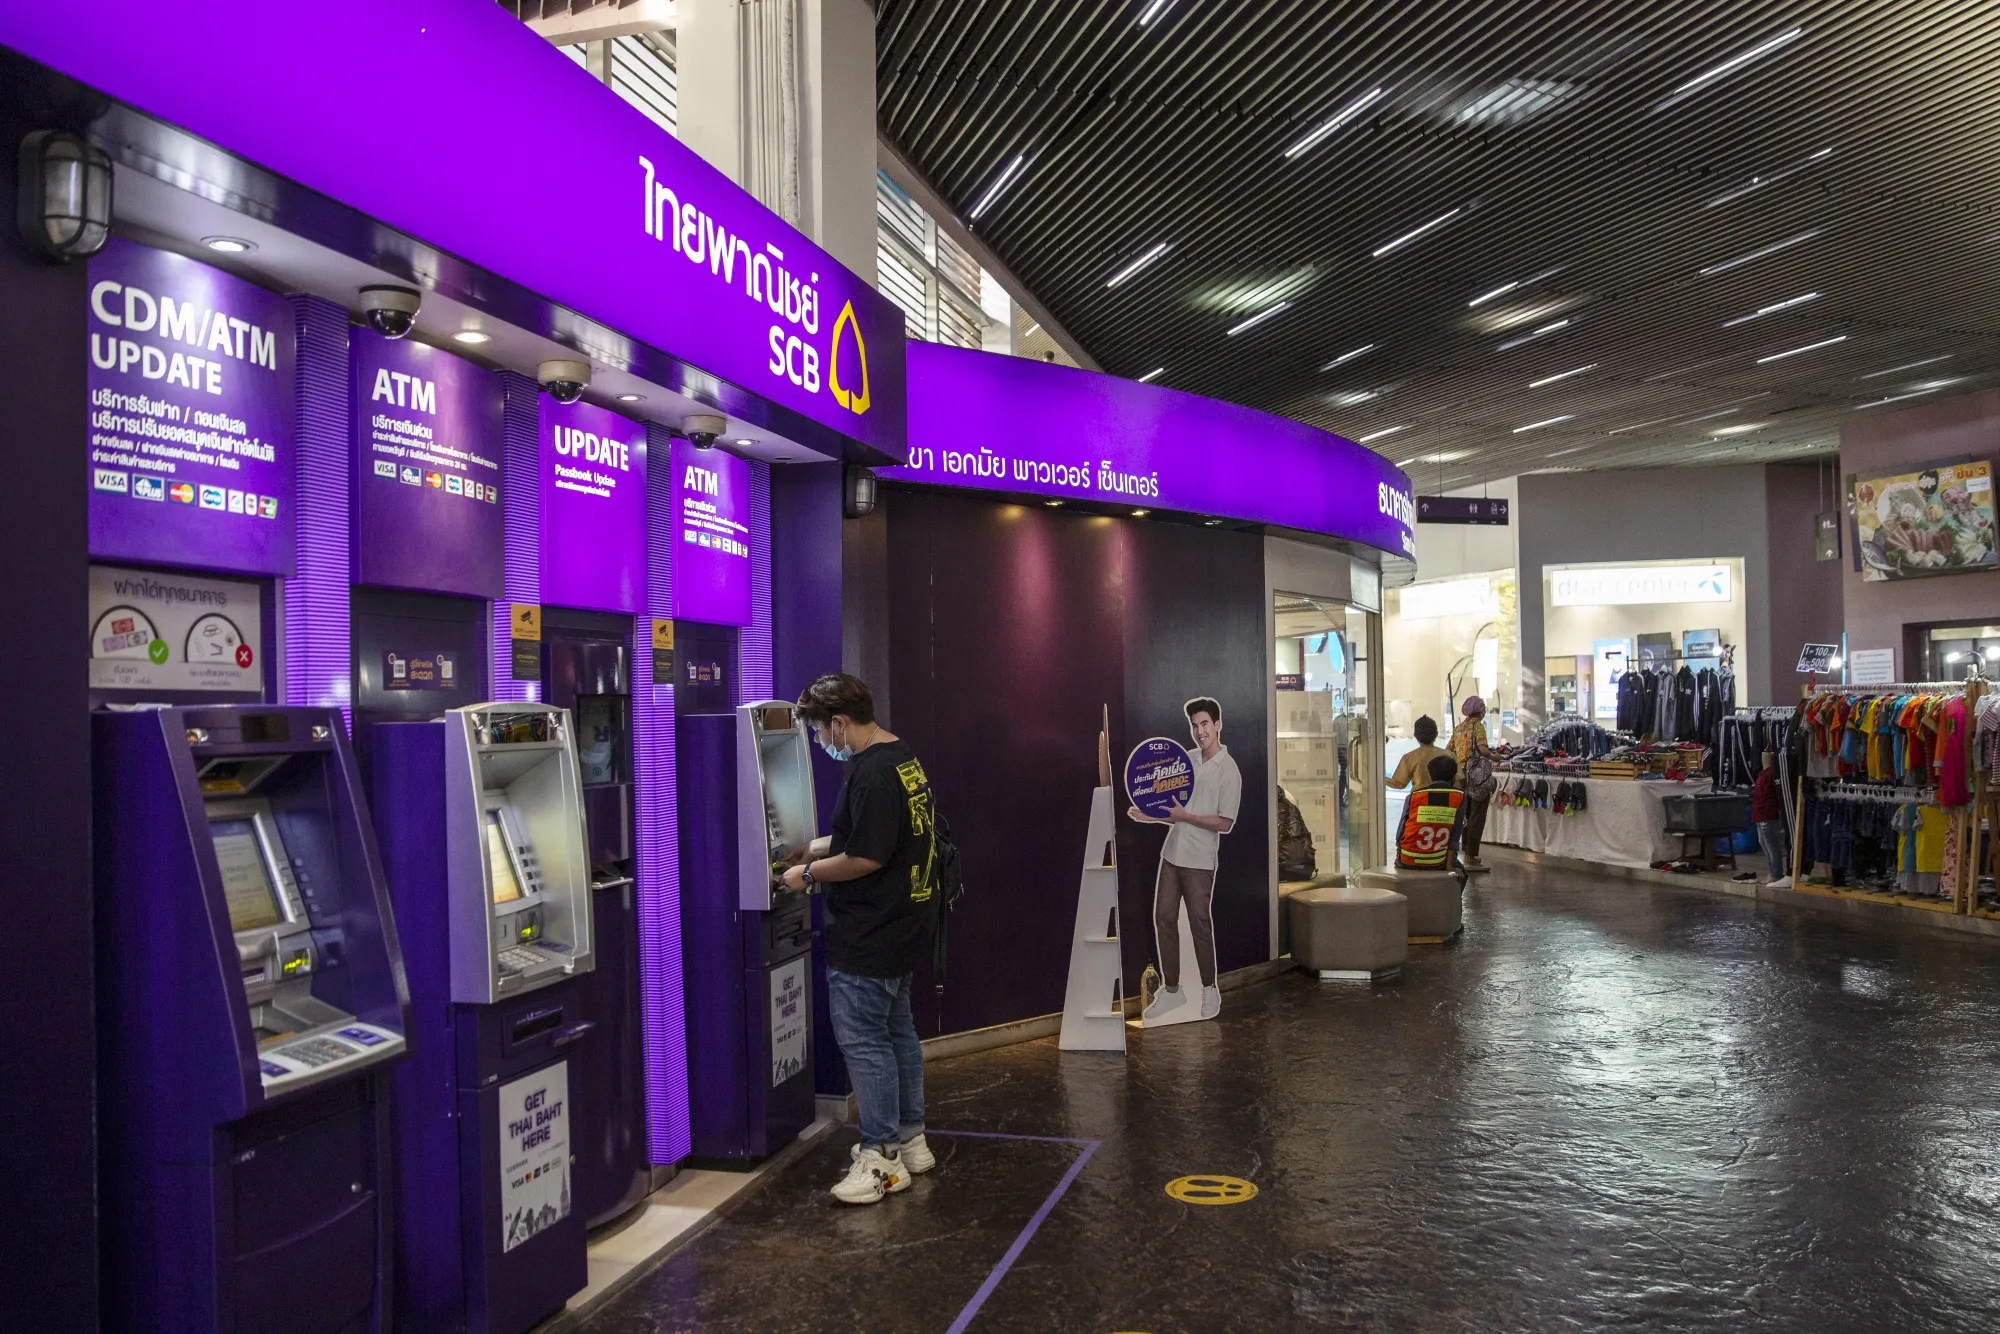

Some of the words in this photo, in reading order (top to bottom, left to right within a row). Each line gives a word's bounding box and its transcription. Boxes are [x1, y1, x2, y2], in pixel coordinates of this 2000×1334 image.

[639, 155, 819, 334] ไทยพาณิชย์
[91, 279, 277, 371] CDM/ATM
[91, 334, 222, 395] UPDATE
[769, 325, 820, 393] SCB
[372, 368, 436, 415] ATM
[92, 388, 180, 421] บริการรับฝาก
[184, 406, 191, 424] /
[554, 424, 629, 471] UPDATE
[98, 473, 125, 487] VISA
[377, 462, 394, 474] VISA
[555, 463, 592, 482] Passbook
[593, 471, 616, 488] Update
[684, 465, 718, 496] ATM
[943, 446, 1006, 478] เอกมัย
[1013, 461, 1090, 488] พาวเวอร์
[1098, 460, 1159, 497] เซ็นเตอร์
[1979, 466, 1987, 476] 3
[114, 578, 228, 607] ฝากได้ทุกธนาคาร
[1416, 826, 1450, 851] 32
[775, 994, 788, 1008] THAI
[789, 986, 802, 1002] BAHT
[783, 976, 794, 991] GET
[781, 1002, 797, 1019] HERE
[524, 1088, 546, 1112] GET
[508, 1115, 533, 1139] THAI
[536, 1102, 562, 1126] BAHT
[521, 1126, 550, 1152] HERE
[511, 1177, 524, 1190] VISA
